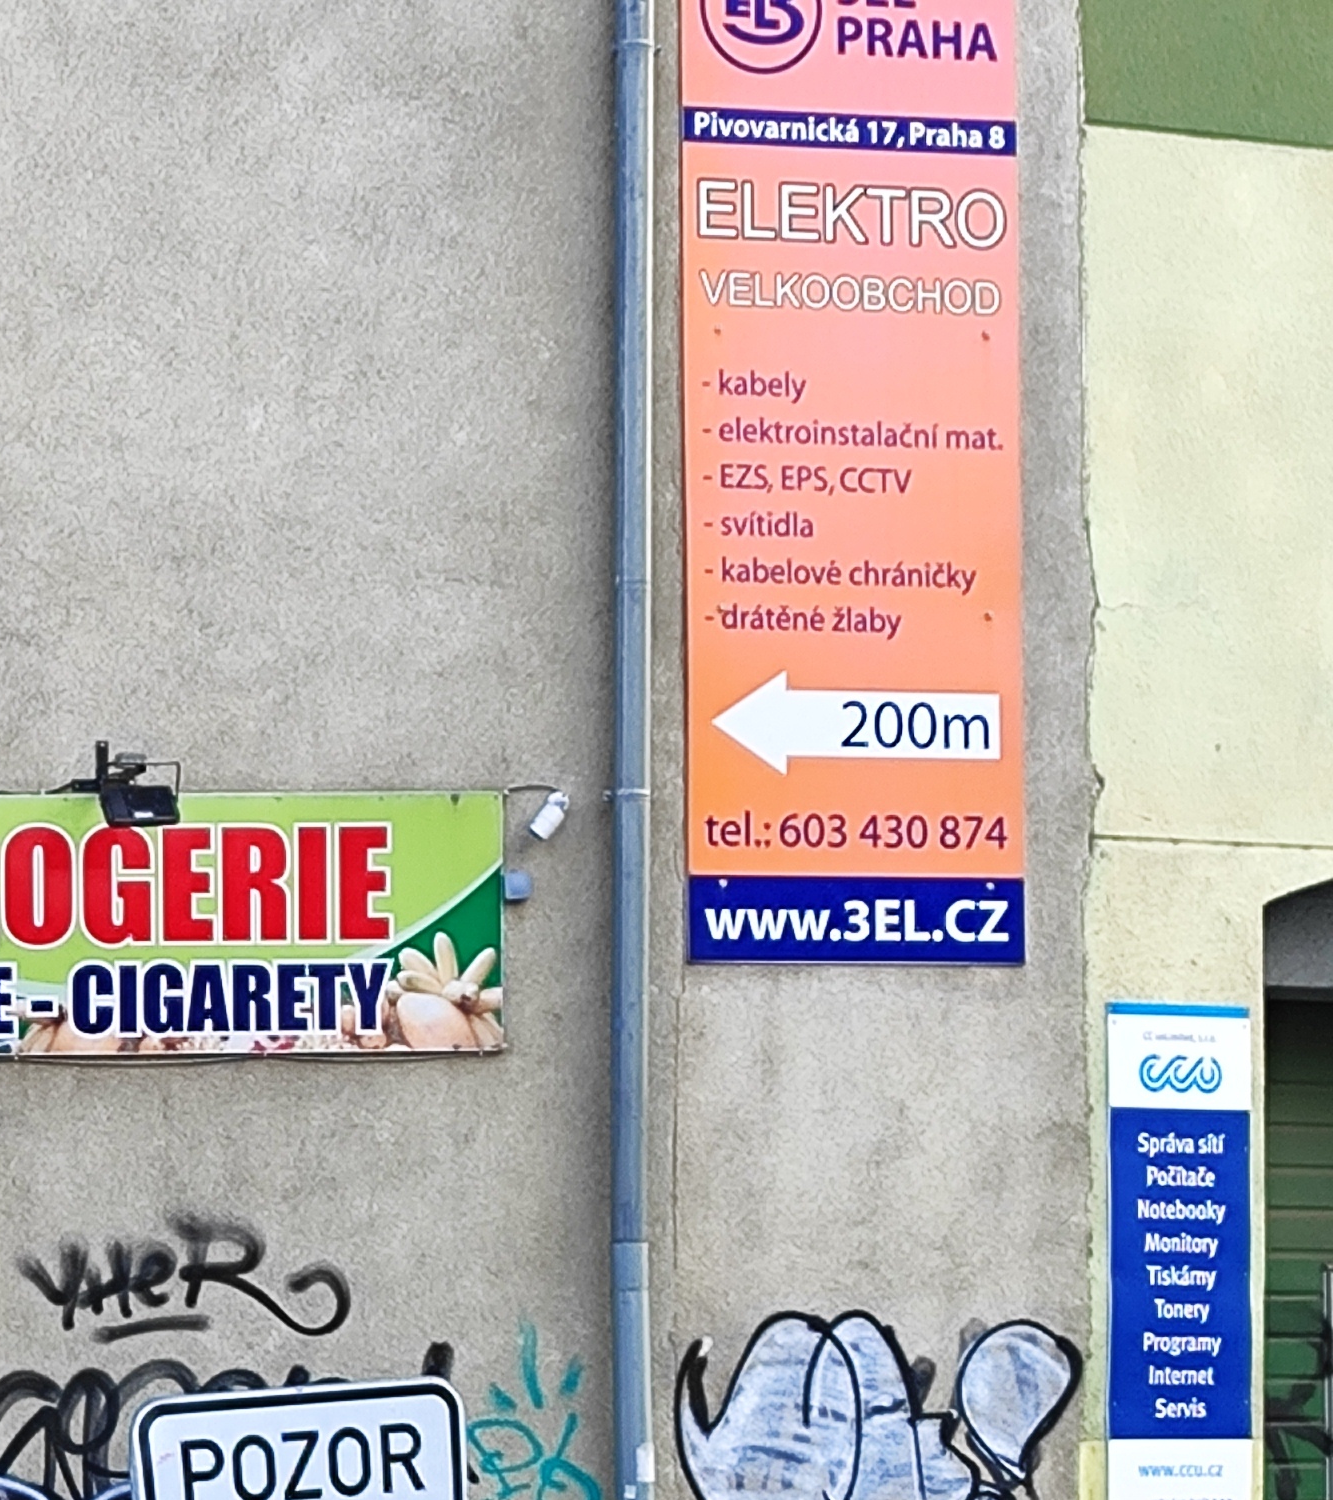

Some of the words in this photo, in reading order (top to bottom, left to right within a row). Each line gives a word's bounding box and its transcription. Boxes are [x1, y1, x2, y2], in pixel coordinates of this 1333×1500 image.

[837, 15, 998, 62] PRAHA
[694, 110, 860, 144] Pivovarnická
[988, 127, 1006, 149] 8
[696, 178, 1008, 249] ELEKTRO
[699, 269, 1001, 315] VELKOOBCHOD
[718, 369, 807, 402] kabely
[718, 417, 937, 448] elektroinstalační
[945, 426, 1003, 450] mat.
[719, 463, 773, 492] EZS,
[781, 466, 834, 496] EPS,
[840, 468, 912, 494] CCTV
[720, 511, 815, 538] svítidla
[720, 556, 842, 586] kabelové
[849, 561, 977, 595] chráničky
[720, 605, 825, 632] drátěné
[833, 606, 902, 640] žlaby
[840, 700, 991, 751] 200m
[705, 811, 772, 848] tel.:
[779, 813, 848, 848] 603
[859, 814, 928, 848] 430
[939, 815, 1008, 850] 874
[704, 898, 1010, 943] www.3EL.CZ
[67, 958, 393, 1039] CIGARETY
[1137, 1131, 1195, 1158] Správa
[1146, 1165, 1216, 1187] Počítače
[1137, 1198, 1226, 1225] Notebooky
[1144, 1232, 1219, 1259] Monitory
[1145, 1264, 1217, 1291] Tiskárny
[1154, 1298, 1210, 1324] Tonery
[1143, 1332, 1222, 1357] Programy
[1148, 1364, 1215, 1386] Internet
[1154, 1396, 1207, 1418] Servis
